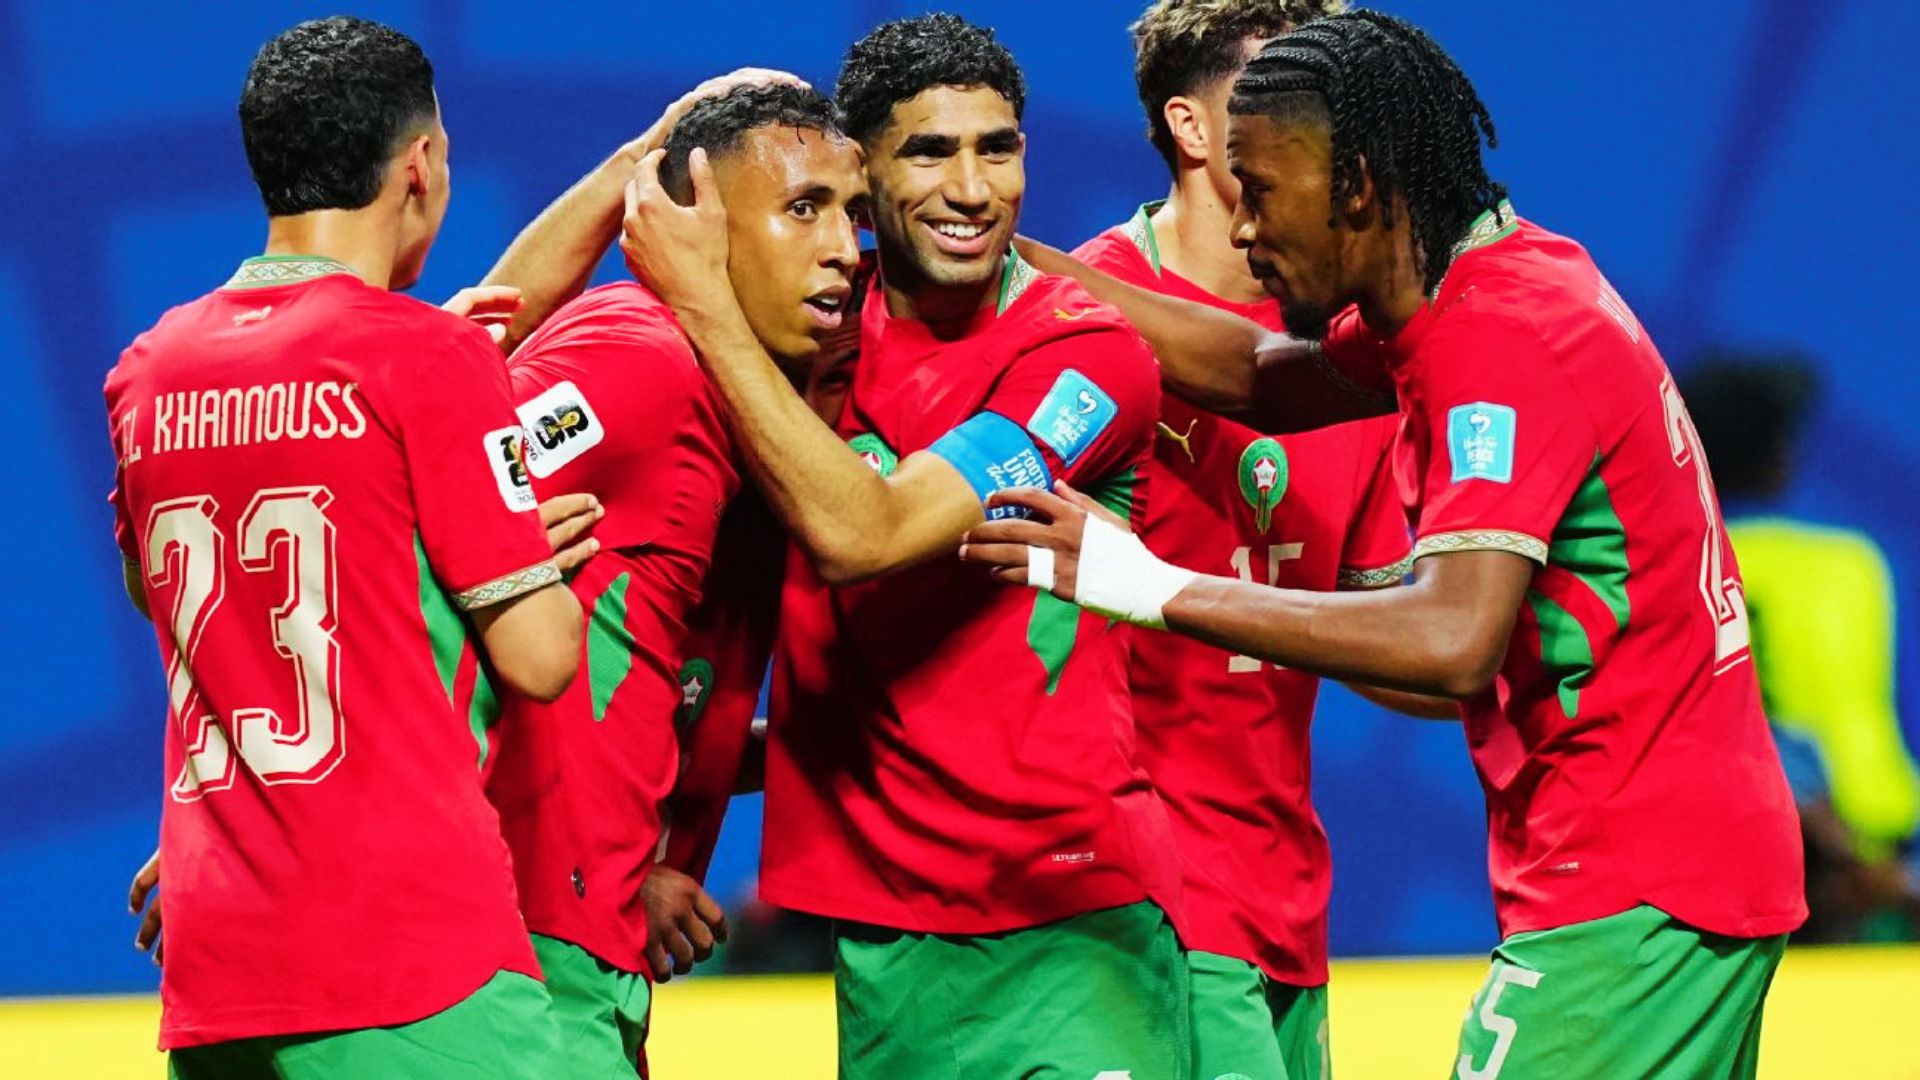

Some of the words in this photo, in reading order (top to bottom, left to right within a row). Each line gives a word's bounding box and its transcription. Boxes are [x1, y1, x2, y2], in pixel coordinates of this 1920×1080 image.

[153, 381, 367, 454] KHANNOUSS
[1002, 456, 1033, 487] UNI
[1018, 448, 1048, 490] FOOTB
[144, 485, 346, 804] 23
[1456, 958, 1547, 1080] 5
